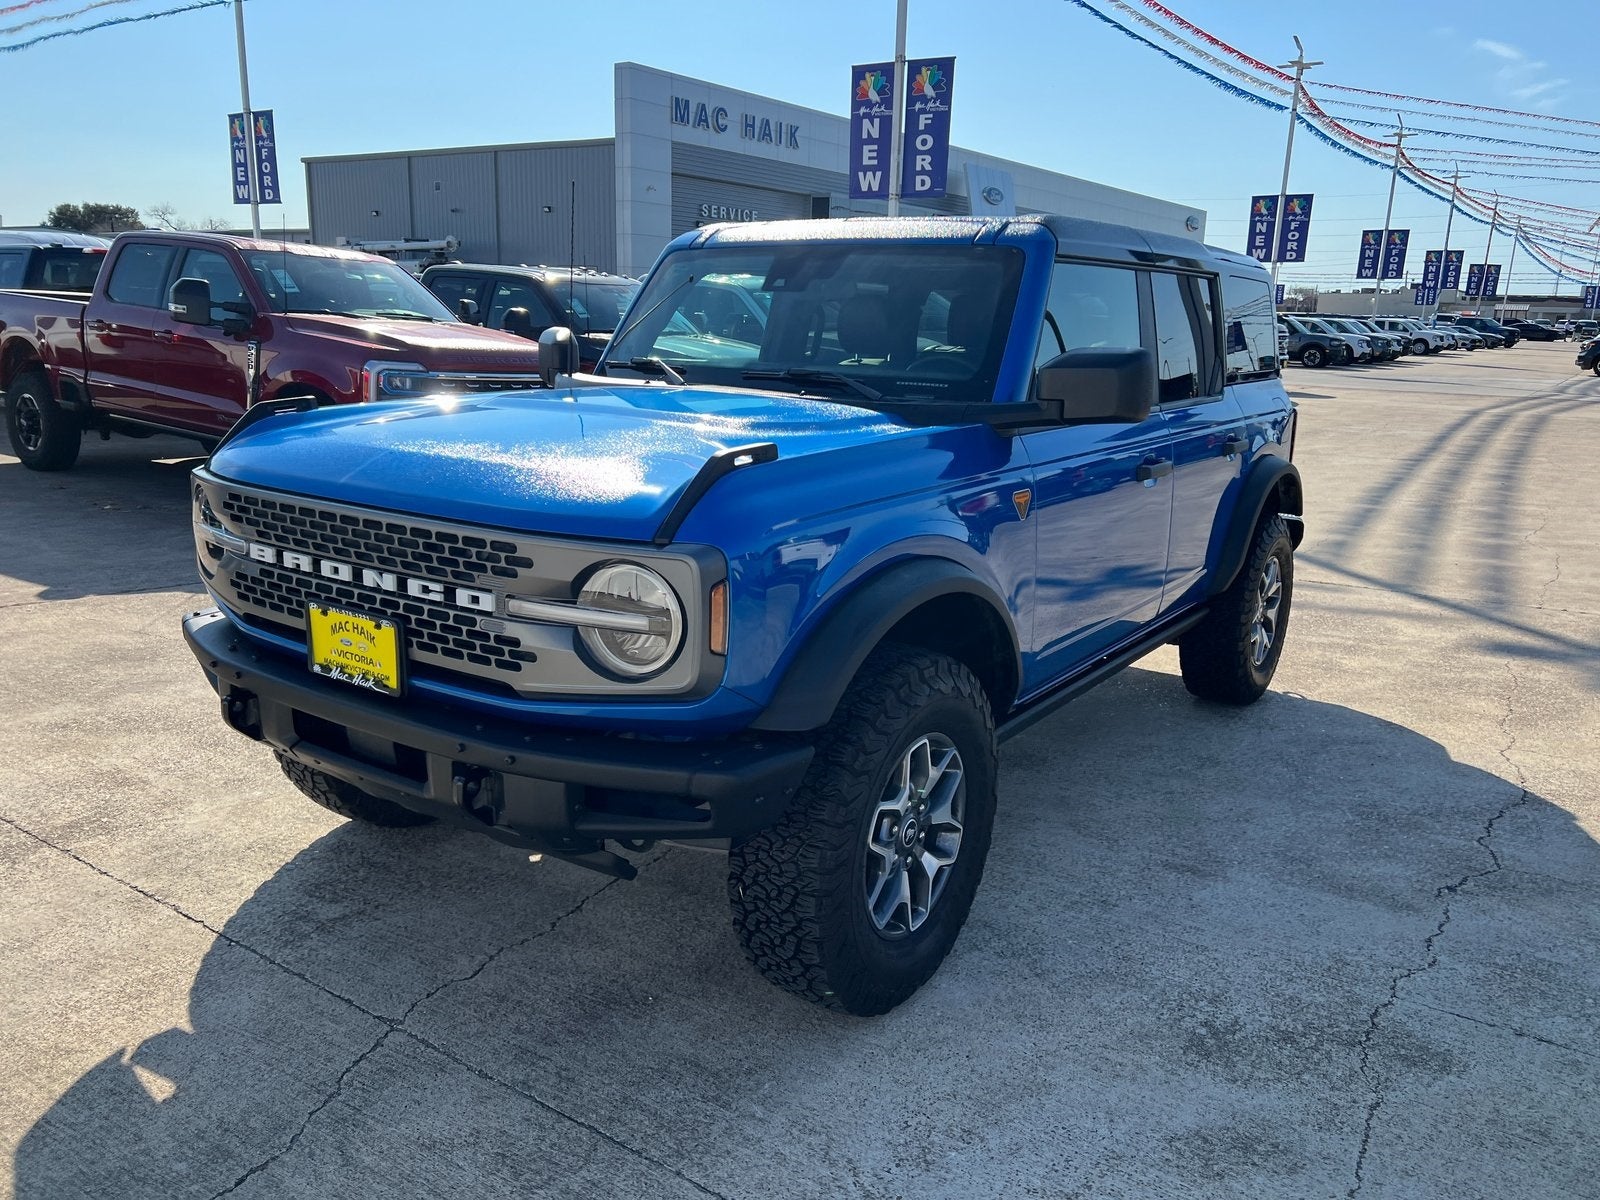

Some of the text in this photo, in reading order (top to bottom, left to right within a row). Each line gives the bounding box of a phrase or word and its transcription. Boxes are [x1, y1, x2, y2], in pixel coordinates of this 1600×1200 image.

[672, 96, 800, 149] MAC HAIK
[858, 118, 882, 192] NEW
[915, 113, 934, 191] FORD
[235, 149, 249, 199] NEW
[261, 148, 274, 200] FORD
[701, 203, 759, 222] SERVICE
[1252, 222, 1268, 260] NEW
[1286, 221, 1300, 260] FORD
[1361, 249, 1375, 277] NEW
[1387, 249, 1400, 278] FORD
[1425, 265, 1437, 288] NEW
[1446, 265, 1456, 288] FORD
[1468, 276, 1478, 295] NEW
[1485, 276, 1494, 295] FORD
[249, 542, 496, 613] BRONCO
[330, 620, 351, 636] MAC
[352, 621, 377, 648] HAIK
[336, 648, 376, 668] VICTORIA
[328, 666, 380, 690] Mac Haik
